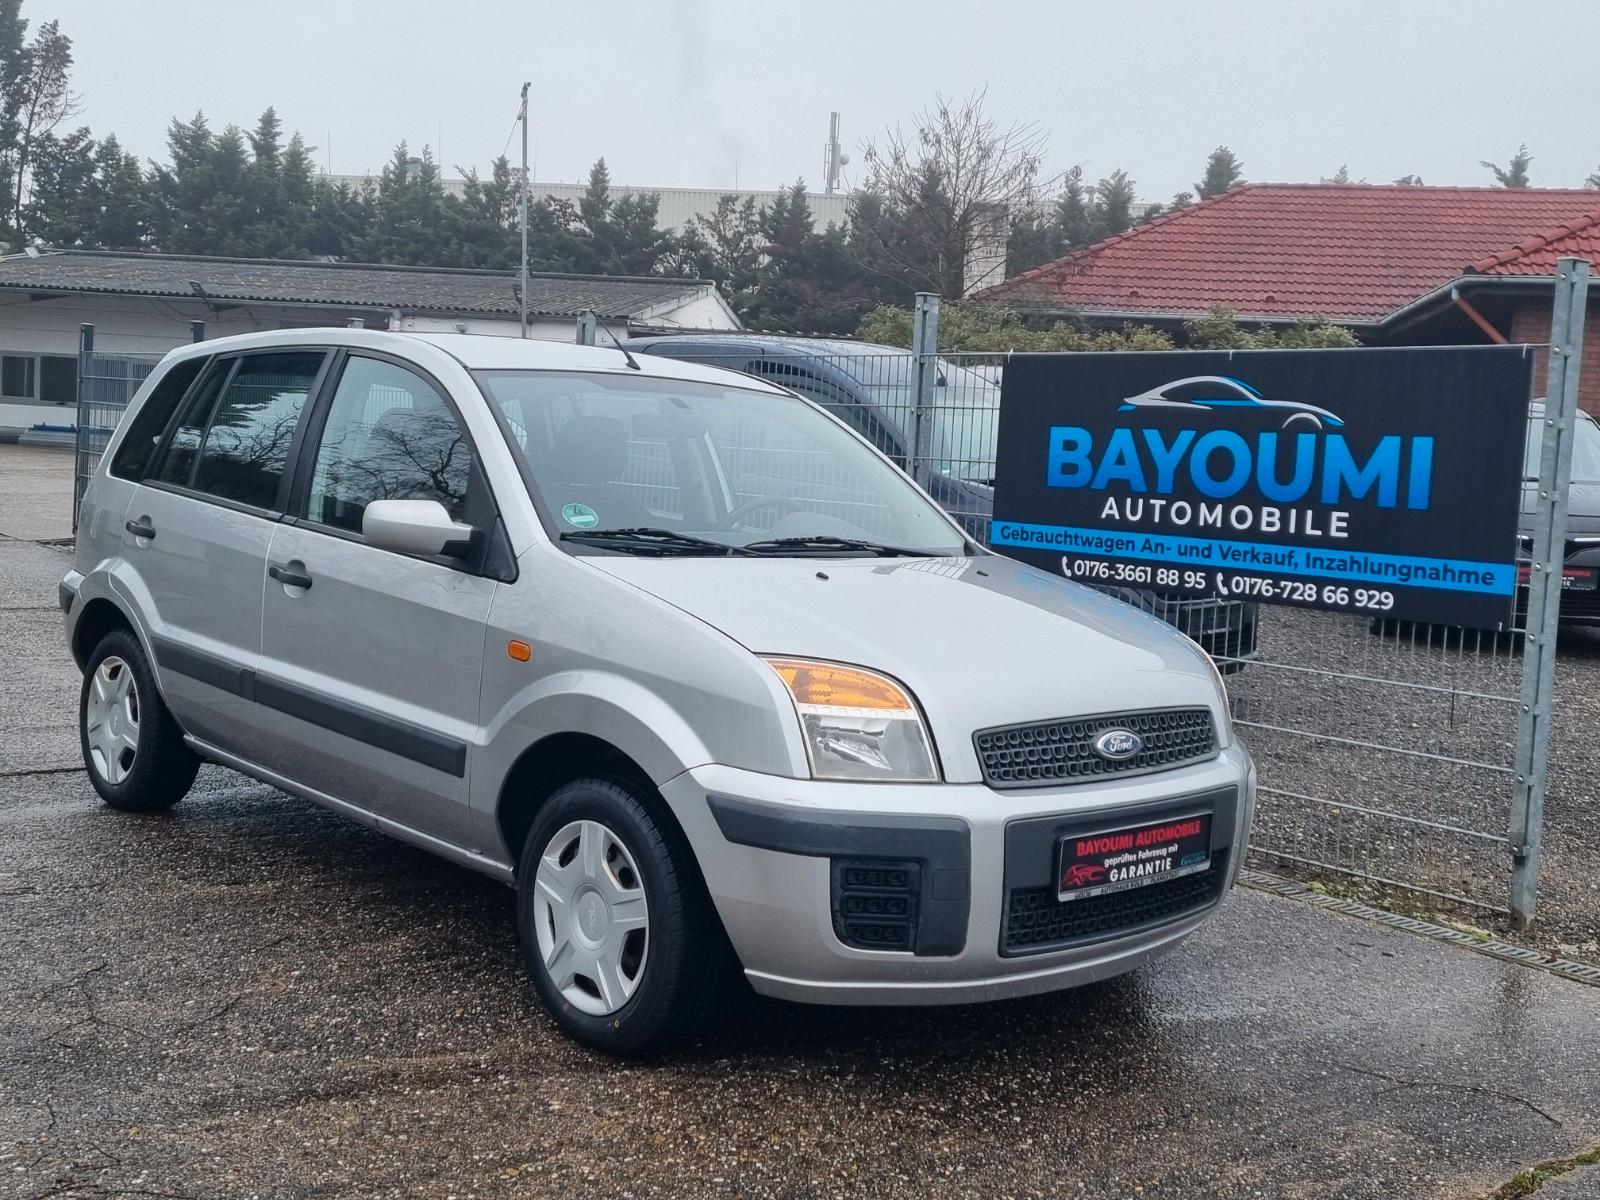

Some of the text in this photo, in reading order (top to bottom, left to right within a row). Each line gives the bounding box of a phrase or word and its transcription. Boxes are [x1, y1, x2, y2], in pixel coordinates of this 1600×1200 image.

[1047, 426, 1434, 510] BAYOUMI
[1101, 497, 1349, 537] AUTOMOBILE
[1000, 525, 1496, 586] Gebrauchtwagen An- und Verkauf, Inzahlungnahme
[1074, 559, 1395, 610] 0176-3661 88 95 0176-728 66 929
[1109, 735, 1133, 752] Ford
[1077, 820, 1201, 857] BAYOUMI AUTOMOBILE
[1104, 853, 1137, 868] geprüftes
[1110, 857, 1172, 882] GARANTIE
